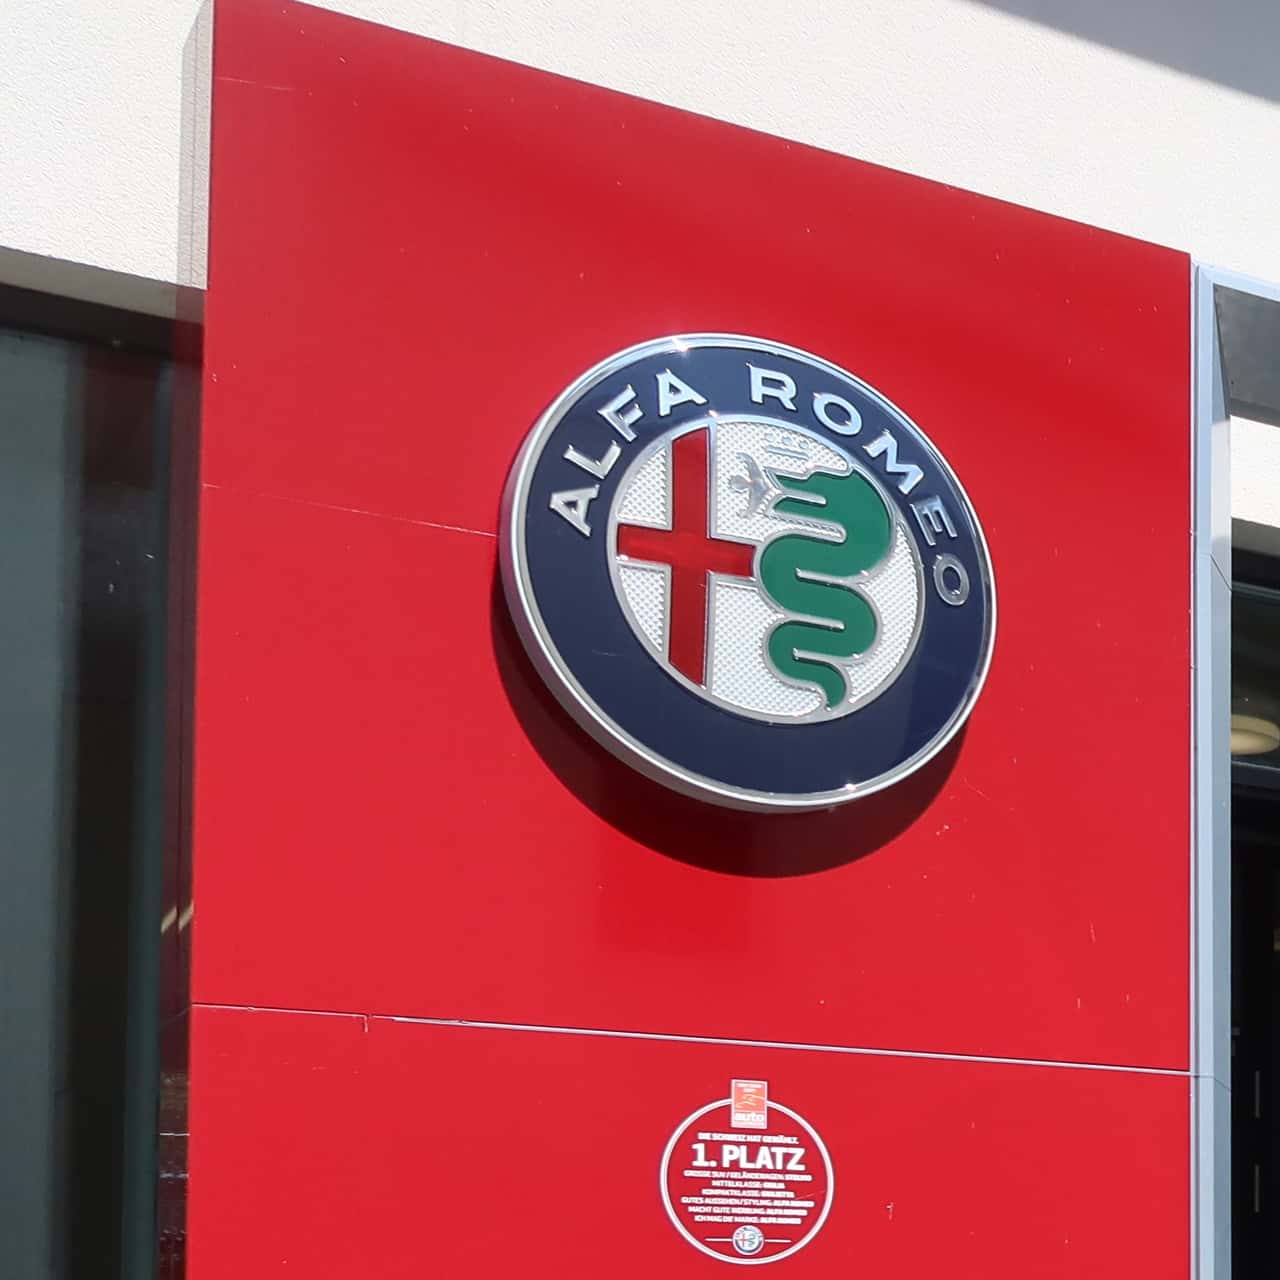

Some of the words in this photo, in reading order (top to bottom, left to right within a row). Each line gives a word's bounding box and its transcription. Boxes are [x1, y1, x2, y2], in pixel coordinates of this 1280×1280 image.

[549, 367, 707, 537] ALFA
[746, 362, 970, 607] ROMEO
[692, 1142, 717, 1168] 1.
[722, 1144, 806, 1171] PLATZ
